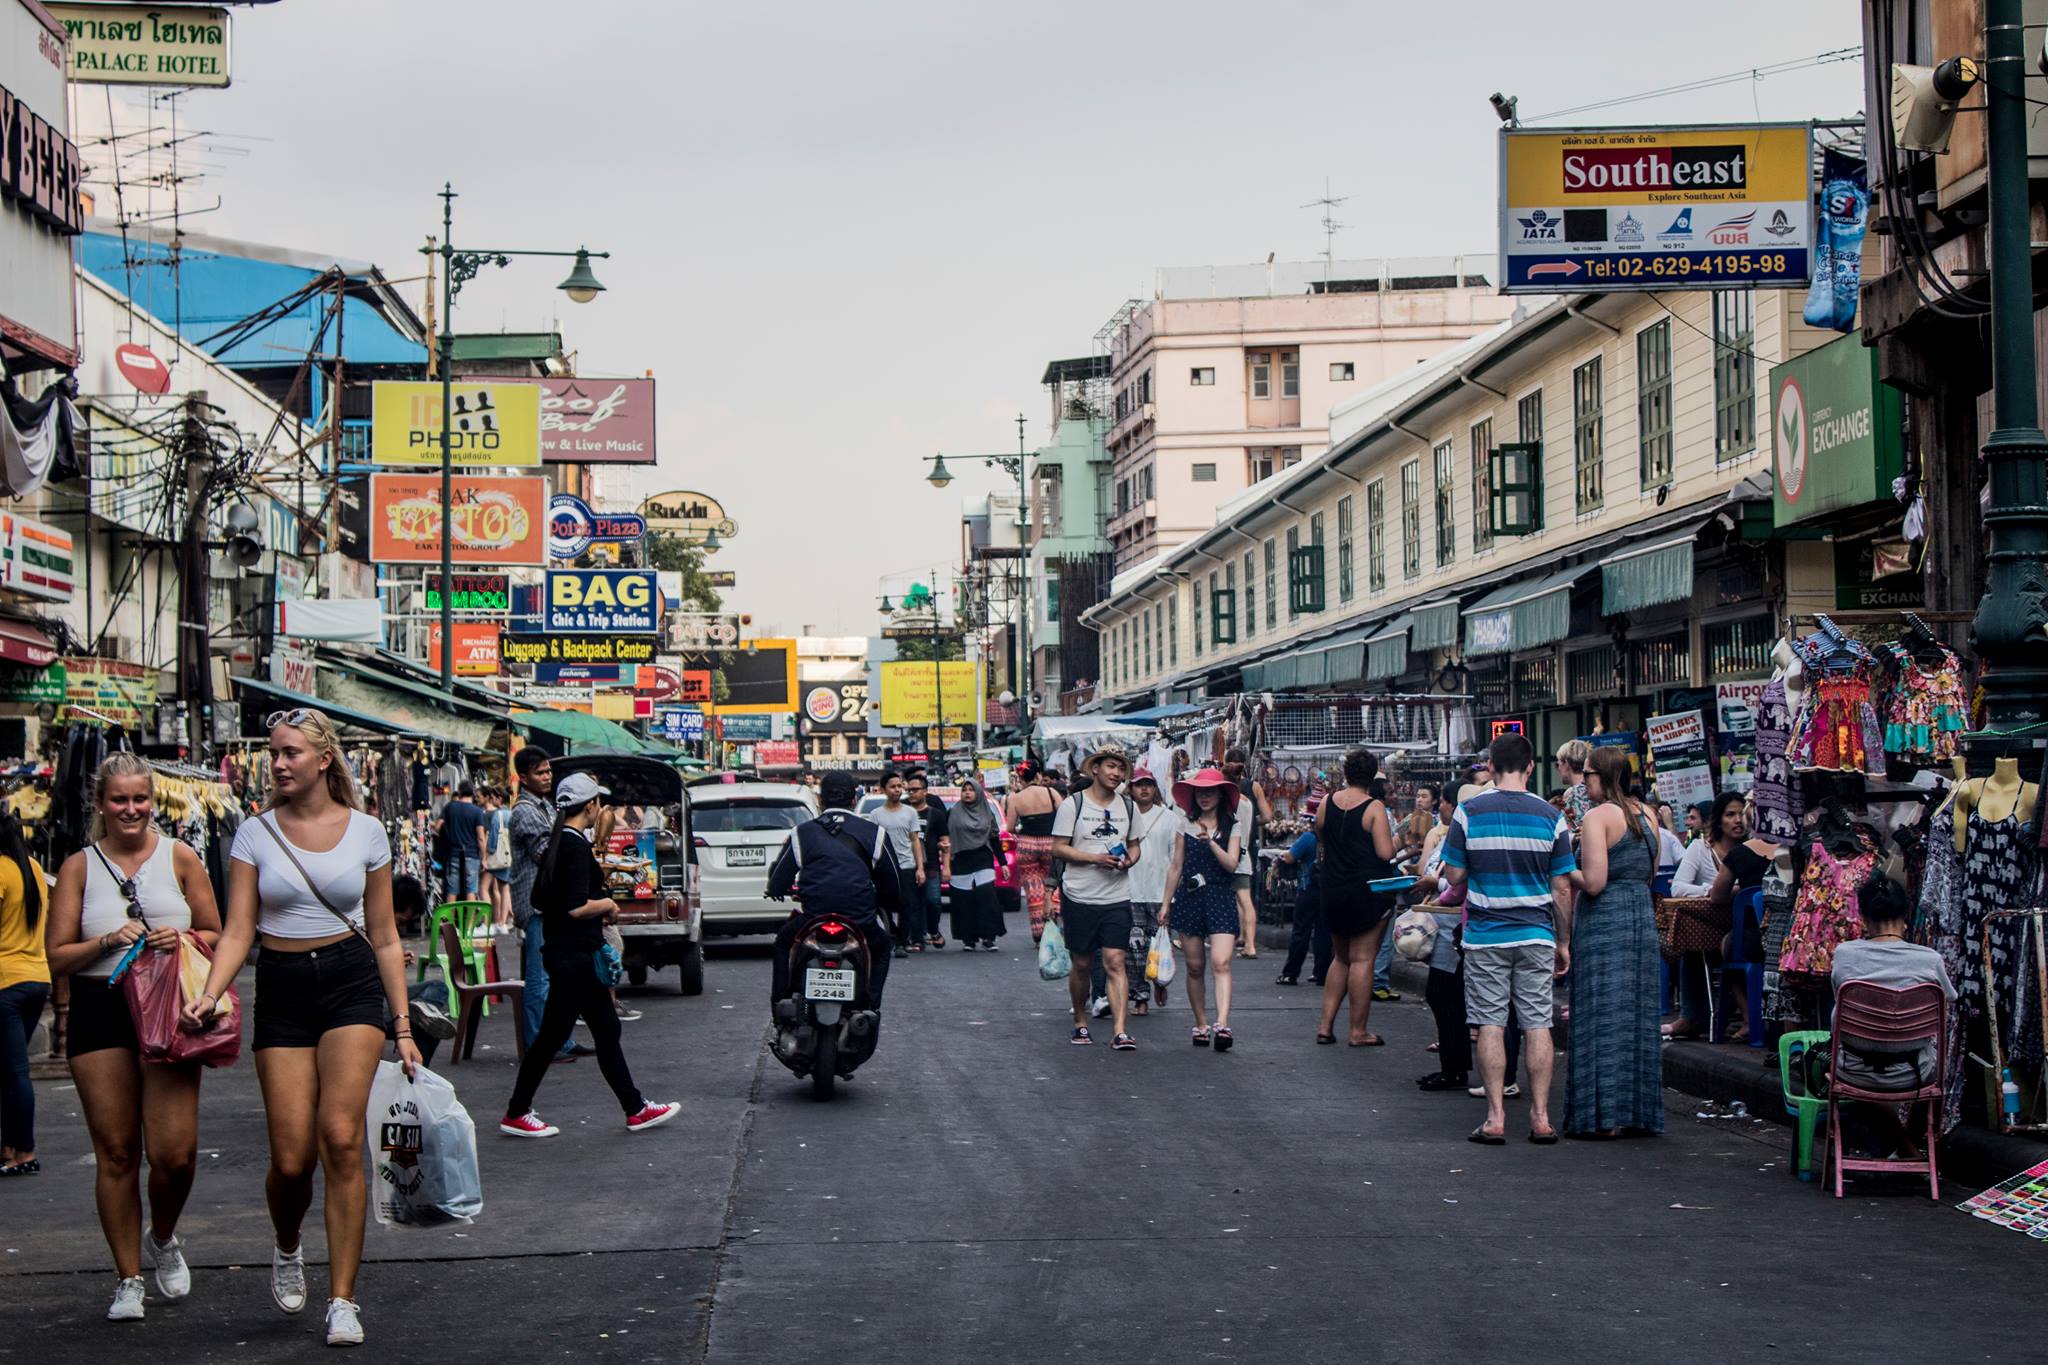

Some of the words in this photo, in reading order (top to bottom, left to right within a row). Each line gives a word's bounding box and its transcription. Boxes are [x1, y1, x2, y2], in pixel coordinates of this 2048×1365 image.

[146, 12, 222, 44] โฮเทล
[76, 51, 148, 72] PALACE
[157, 55, 221, 75] HOTEL
[18, 99, 84, 235] BEER
[1564, 153, 1745, 188] Southeast
[1648, 193, 1681, 202] Explore
[1683, 191, 1725, 200] Southeast
[1727, 191, 1746, 199] Asia
[1523, 228, 1557, 238] IATA
[1713, 232, 1749, 245] บขส
[541, 384, 627, 424] oof
[1813, 408, 1870, 454] EXCHANGE
[409, 431, 499, 449] PHOTO
[559, 439, 571, 450] &
[575, 440, 602, 451] Live
[606, 440, 644, 452] Music
[549, 519, 591, 537] Point
[596, 520, 641, 537] Plaza
[553, 575, 649, 606] BAG
[552, 612, 574, 627] Chic
[576, 613, 585, 626] &
[589, 613, 609, 629] Trip
[612, 612, 650, 627] Station
[468, 647, 497, 660] ATM
[503, 638, 547, 662] Luggage
[550, 639, 559, 659] &
[563, 639, 612, 662] Backpack
[616, 639, 652, 659] Center
[665, 712, 680, 728] SIM
[681, 712, 703, 728] CARD
[1650, 722, 1675, 736] MINI
[1676, 715, 1697, 728] BUS
[1663, 724, 1702, 741] AIRPORT
[810, 760, 852, 770] BURGER
[857, 760, 884, 770] KING
[1688, 758, 1708, 766] DMK
[813, 989, 846, 998] 2248
